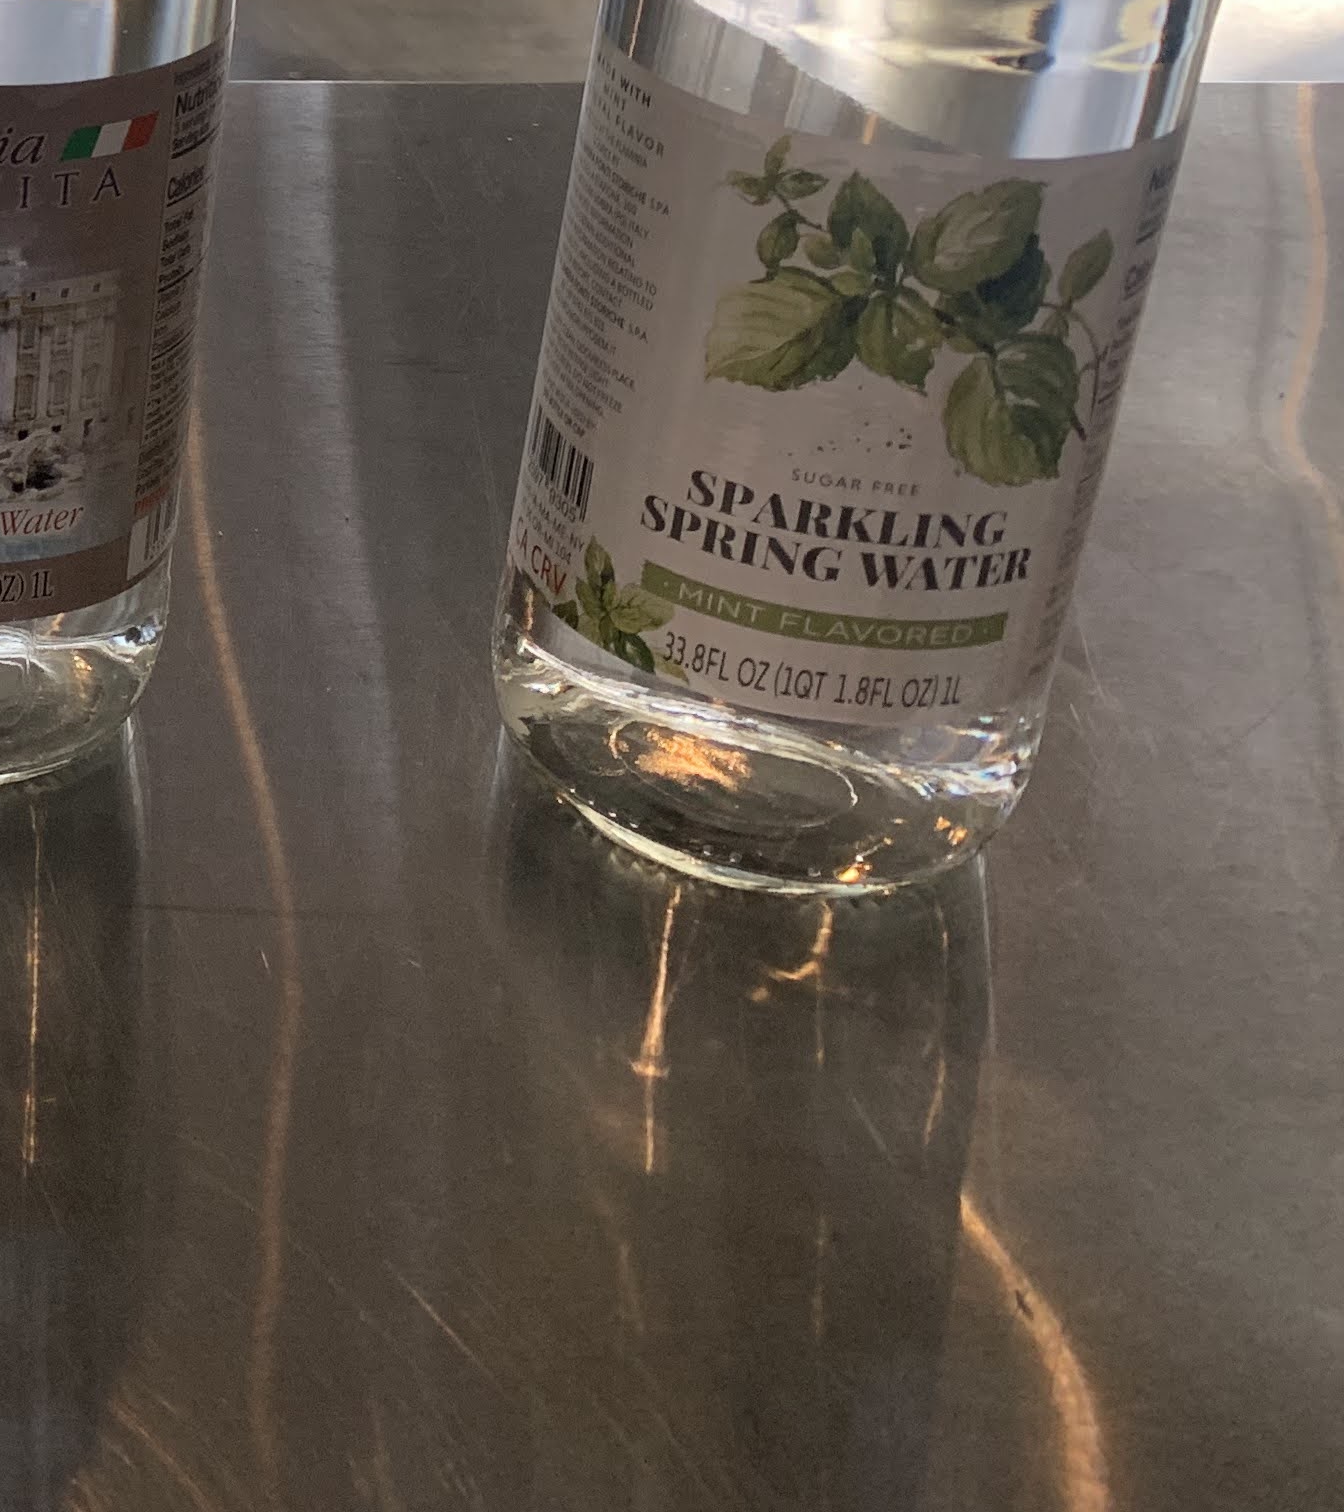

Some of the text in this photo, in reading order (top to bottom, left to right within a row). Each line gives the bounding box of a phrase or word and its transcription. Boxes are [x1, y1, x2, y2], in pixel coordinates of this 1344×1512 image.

[620, 74, 651, 108] WITH
[791, 468, 921, 497] SUGAR FREE
[0, 505, 84, 536] Water
[686, 470, 1009, 549] SPARKLING
[640, 494, 843, 583] SPRING
[859, 547, 1032, 591] WATER
[31, 570, 54, 600] 1L
[531, 544, 567, 596] CRV
[679, 582, 973, 645] MINT FLAVORED
[737, 657, 771, 692] OZ
[773, 661, 829, 700] (1QT
[833, 673, 893, 709] 1.8FL
[901, 674, 940, 711] OZ)
[940, 675, 961, 706] 1L
